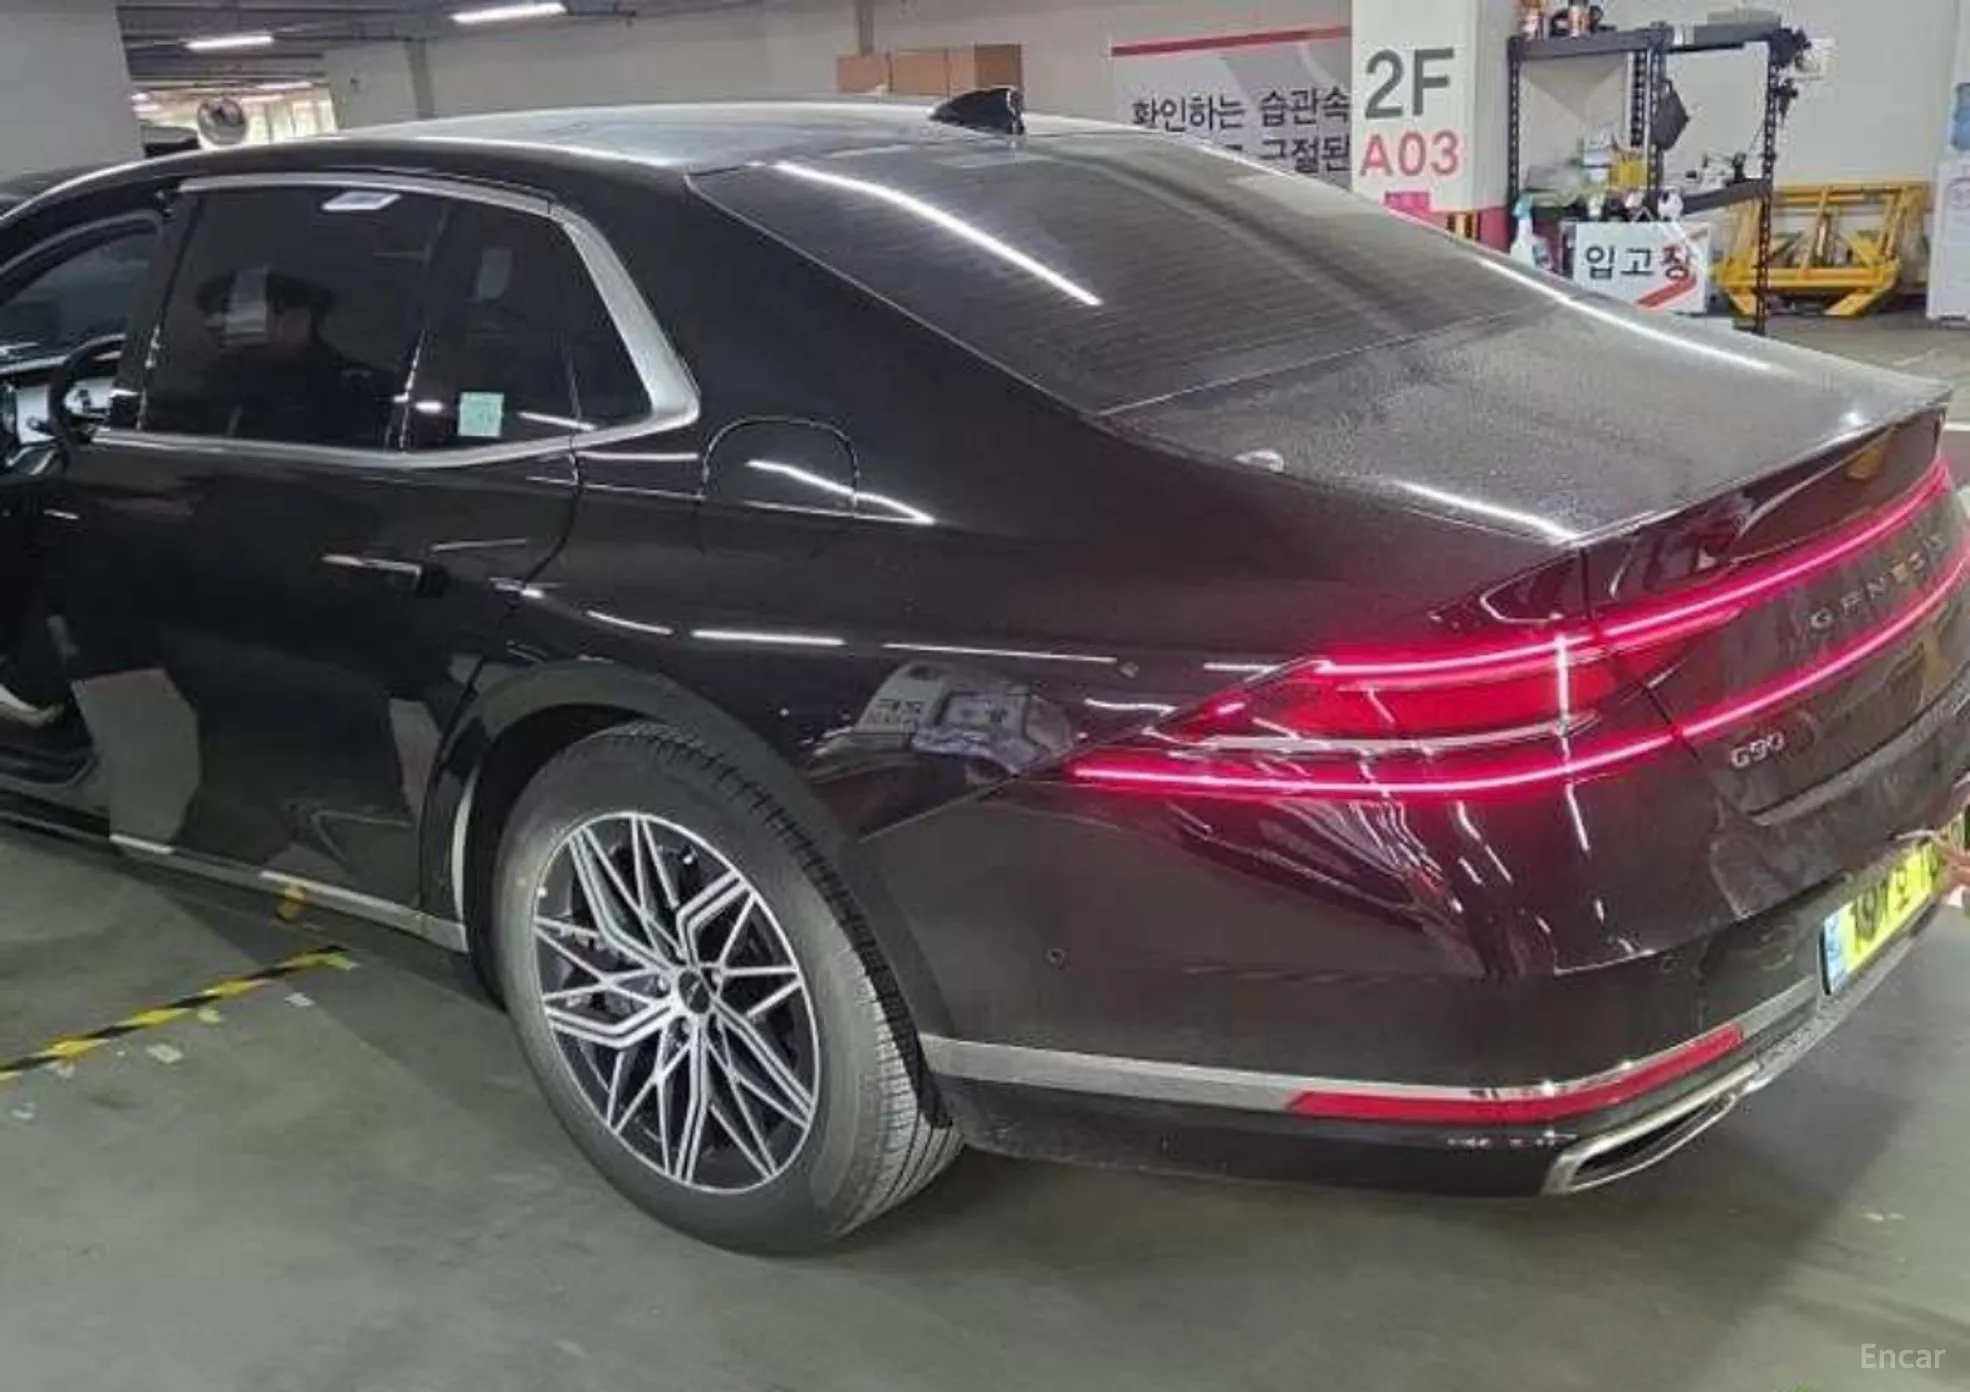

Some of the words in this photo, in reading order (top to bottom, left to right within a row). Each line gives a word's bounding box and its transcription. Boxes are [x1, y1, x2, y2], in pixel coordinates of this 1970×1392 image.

[1364, 47, 1456, 120] 2F
[1360, 130, 1460, 178] A03
[1731, 731, 1785, 768] G90
